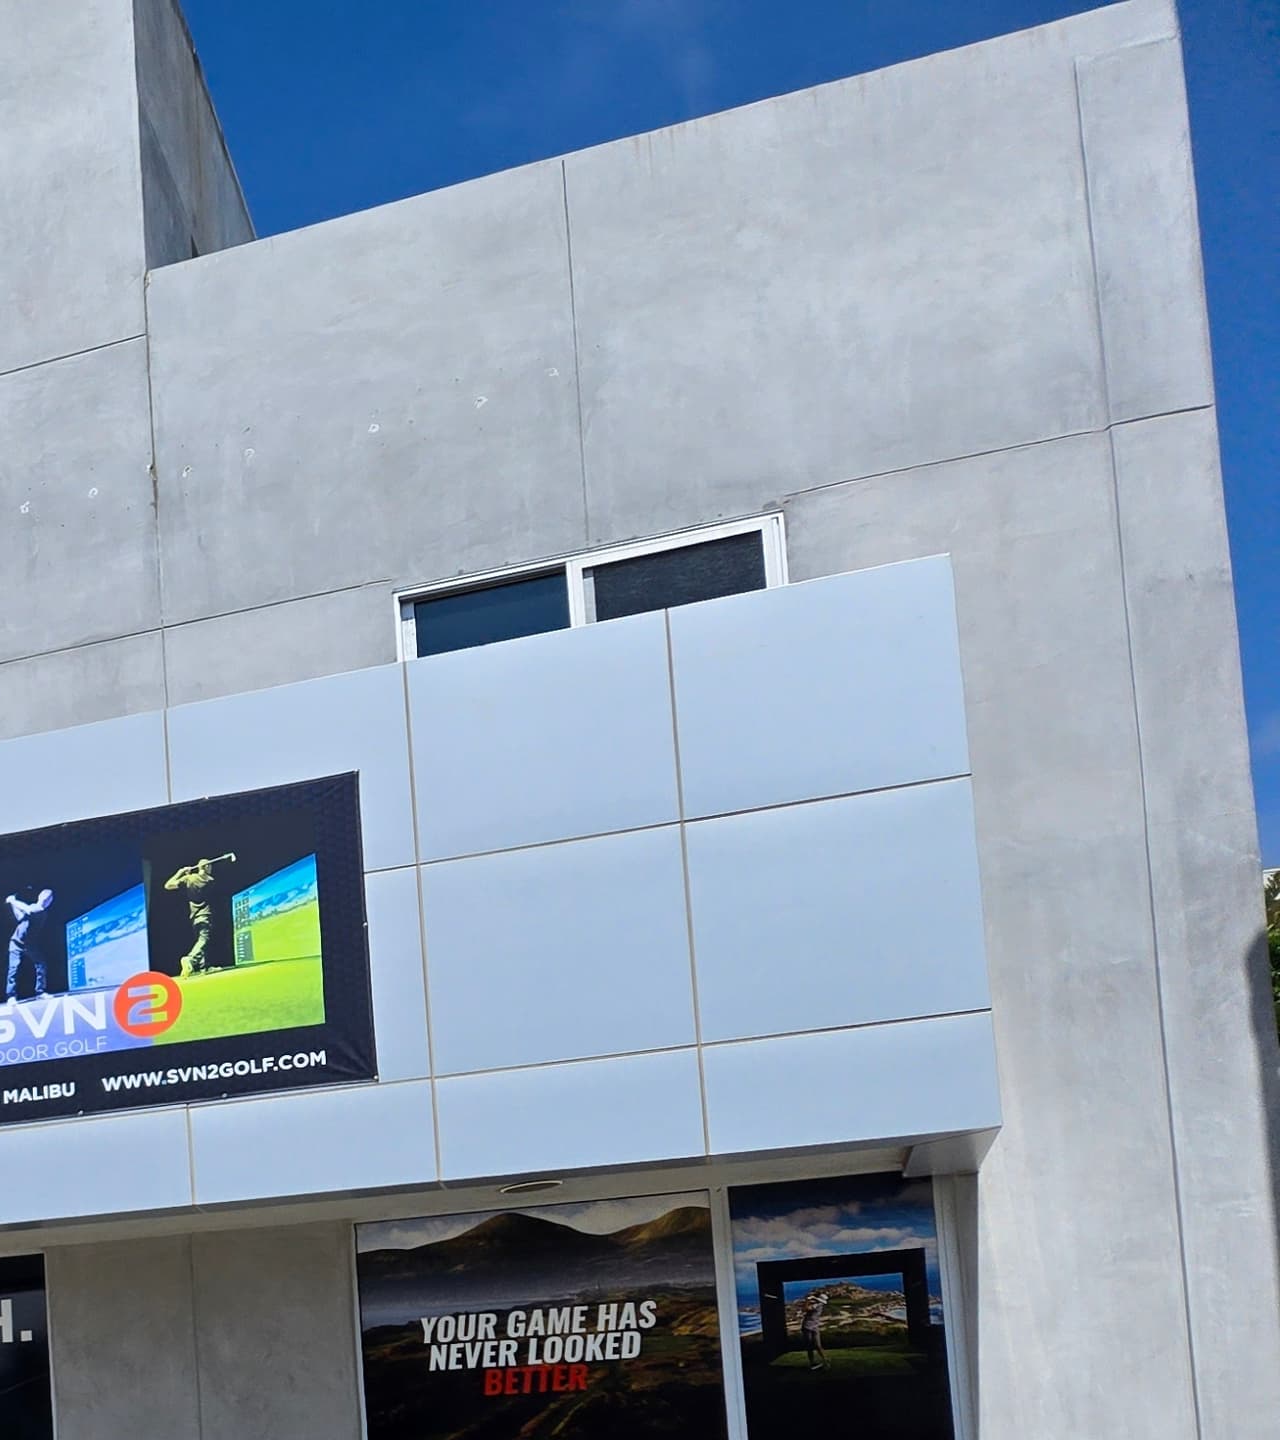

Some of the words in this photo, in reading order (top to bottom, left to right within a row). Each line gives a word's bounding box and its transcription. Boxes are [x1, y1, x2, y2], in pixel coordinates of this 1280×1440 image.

[54, 1036, 108, 1059] GOLF
[102, 1050, 327, 1092] WWW.SVN2GOLF.COM
[3, 1081, 75, 1105] MALIBU
[419, 1312, 498, 1346] YOUR
[506, 1305, 587, 1339] GAME
[598, 1299, 657, 1331] HAS
[429, 1338, 518, 1372] NEVER
[527, 1329, 642, 1365] LOOKED
[483, 1363, 589, 1396] BETTER
